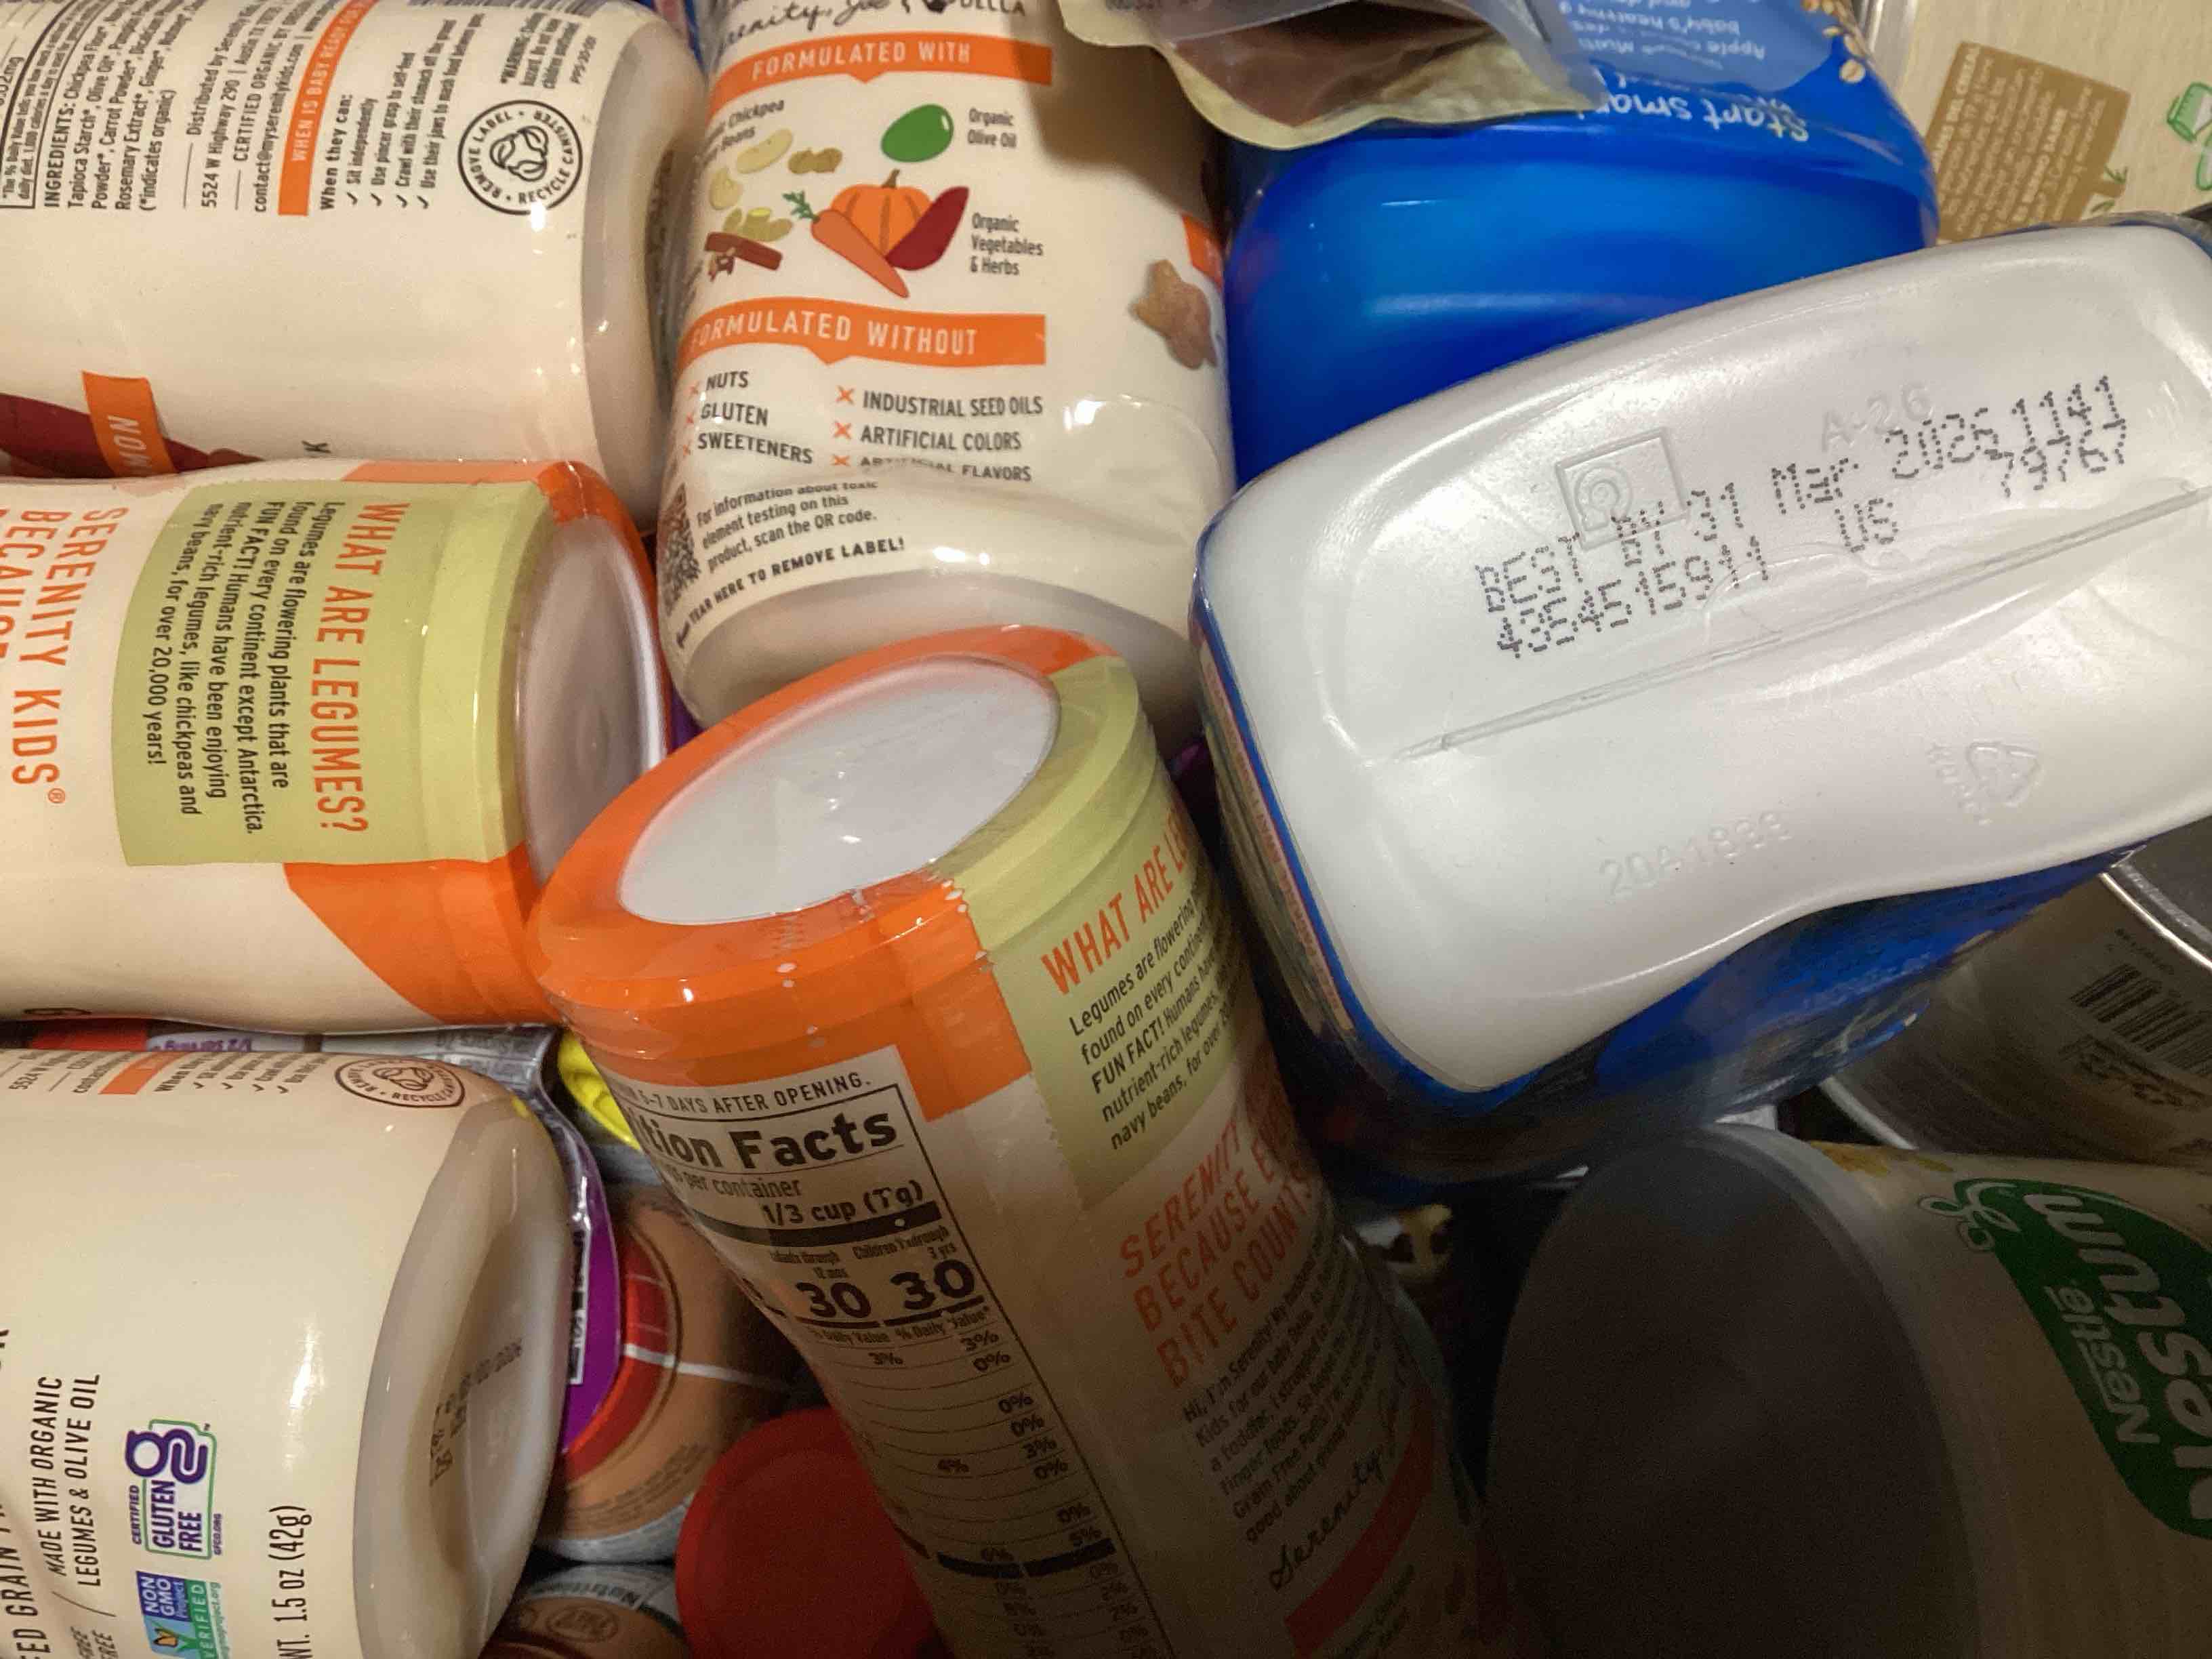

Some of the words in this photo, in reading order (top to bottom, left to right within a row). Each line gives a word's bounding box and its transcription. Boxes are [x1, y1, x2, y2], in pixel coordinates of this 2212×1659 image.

[752, 42, 906, 81] FORMULATED
[918, 41, 971, 64] WITH
[186, 69, 219, 135] Distributed
[220, 79, 240, 102] 290
[233, 93, 262, 161] CERTIFIED
[251, 41, 283, 89] ORGANIC
[302, 100, 319, 115] IS
[336, 94, 353, 123] can:
[100, 107, 123, 145] Carrot
[208, 104, 236, 155] Highway
[291, 119, 314, 161] WHEN
[473, 110, 512, 143] LABEL
[533, 110, 574, 164] CANISTER
[968, 129, 997, 146] Olive
[969, 106, 1014, 127] Organic
[1704, 98, 1809, 142] Start
[44, 103, 76, 207] INGREDIENTS:
[68, 159, 87, 207] Tapioca
[86, 75, 108, 102] Olive
[205, 158, 220, 169] W
[326, 129, 347, 161] they
[115, 146, 140, 209] Rosemary
[201, 173, 219, 208] 5524
[320, 168, 337, 209] When
[468, 147, 502, 199] REMOVE
[518, 167, 570, 205] RECYCLE
[971, 234, 1044, 256] Vegetables
[972, 211, 1019, 232] Organic
[981, 258, 1020, 276] Herbs
[690, 309, 851, 350] FORMULATED
[867, 320, 978, 356] WITHOUT
[705, 370, 749, 392] NUTS
[862, 390, 966, 417] INDUSTRIAL
[969, 396, 1006, 417] SEED
[1009, 396, 1044, 415] OILS
[701, 402, 769, 427] GLUTEN
[860, 425, 958, 451] ARTIFICIAL
[962, 431, 1022, 451] COLORS
[697, 431, 814, 464] SWEETENERS
[962, 464, 1033, 482] FLAVORS
[255, 501, 287, 524] FUN
[279, 501, 315, 535] found
[696, 508, 712, 528] For
[713, 487, 794, 517] information
[797, 482, 838, 495] about
[701, 516, 745, 550] element
[747, 501, 796, 527] testing
[800, 498, 818, 512] on
[822, 495, 849, 508] this
[1836, 498, 1898, 553] US
[198, 501, 253, 581] nutrient-rich
[232, 527, 270, 569] FACT!
[268, 537, 290, 556] on
[299, 501, 346, 558] Legumes
[335, 503, 411, 575] WHAT
[707, 537, 753, 573] product,
[754, 526, 785, 548] scan
[787, 520, 811, 537] the
[815, 513, 835, 530] QR
[838, 508, 878, 525] code.
[1475, 531, 1584, 613] BEST
[1611, 501, 1664, 567] BY
[1686, 482, 1743, 541] 31
[1771, 456, 1859, 515] Mar
[170, 531, 210, 576] beans,
[289, 562, 310, 585] are
[0, 510, 73, 659] BECAU
[18, 508, 130, 666] SERENITY
[165, 579, 188, 602] for
[215, 573, 249, 632] Humans
[249, 559, 280, 600] every
[689, 597, 714, 625] TEAR
[713, 578, 746, 604] HERE
[747, 568, 767, 586] TO
[771, 548, 836, 576] REMOVE
[841, 536, 906, 558] LABEL!
[156, 606, 176, 640] over
[178, 586, 216, 655] legumes,
[268, 588, 307, 659] flowering
[316, 585, 373, 644] ARE
[209, 636, 234, 676] have
[239, 604, 266, 679] continent
[147, 647, 172, 706] 20,000
[177, 661, 201, 691] like
[267, 665, 292, 717] plants
[205, 682, 229, 720] been
[233, 684, 258, 743] except
[142, 712, 167, 764] years!
[170, 696, 197, 779] chickpeas
[268, 723, 291, 756] that
[310, 658, 369, 832] LEGUMES?
[202, 726, 229, 798] enjoying
[271, 762, 289, 788] are
[179, 785, 202, 815] and
[237, 747, 266, 834] Antarctica.
[1040, 892, 1130, 996] WHAT
[1134, 845, 1173, 923] ARE
[1069, 972, 1134, 1036] Legumes
[1135, 951, 1155, 981] are
[1081, 1015, 1126, 1065] found
[1126, 1004, 1144, 1028] on
[1143, 971, 1174, 1011] every
[1091, 1052, 1126, 1094] FUN
[1126, 1017, 1166, 1065] FACT!
[1163, 976, 1202, 1028] Humans
[668, 1095, 708, 1113] DAYS
[713, 1093, 769, 1115] AFTER
[774, 1071, 872, 1107] OPENING.
[1102, 1036, 1184, 1122] nutrient-rich
[1111, 1111, 1147, 1150] navy
[1147, 1073, 1187, 1120] beans,
[1187, 1050, 1202, 1076] for
[729, 1111, 898, 1169] Facts
[712, 1178, 802, 1198] container
[762, 1202, 804, 1227] 1/3
[811, 1202, 857, 1222] cup
[1133, 1167, 1259, 1332] BECAUSE
[796, 1282, 872, 1318] 30
[890, 1258, 976, 1310] 30
[1156, 1286, 1238, 1390] BITE
[972, 1353, 1010, 1372] 0%
[2043, 1281, 2160, 1444] Nestlé
[70, 1373, 101, 1410] OIL
[998, 1392, 1035, 1414] 0%
[30, 1376, 63, 1471] ORGANIC
[64, 1417, 91, 1480] OLIVE
[32, 1476, 61, 1523] WITH
[68, 1488, 89, 1500] &
[128, 1485, 142, 1546] CERTIFIED
[150, 1479, 176, 1549] GLUTEN
[37, 1528, 67, 1577] MADE
[69, 1504, 101, 1587] LEGUMES
[178, 1511, 203, 1553] FREE
[268, 1505, 312, 1561] (42g)
[0, 1544, 39, 1618] GRAIN
[141, 1576, 159, 1614] NON
[156, 1578, 176, 1617] GMO
[279, 1568, 305, 1589] oz
[190, 1584, 216, 1659] VERIFIED
[272, 1598, 308, 1622] 1.5
